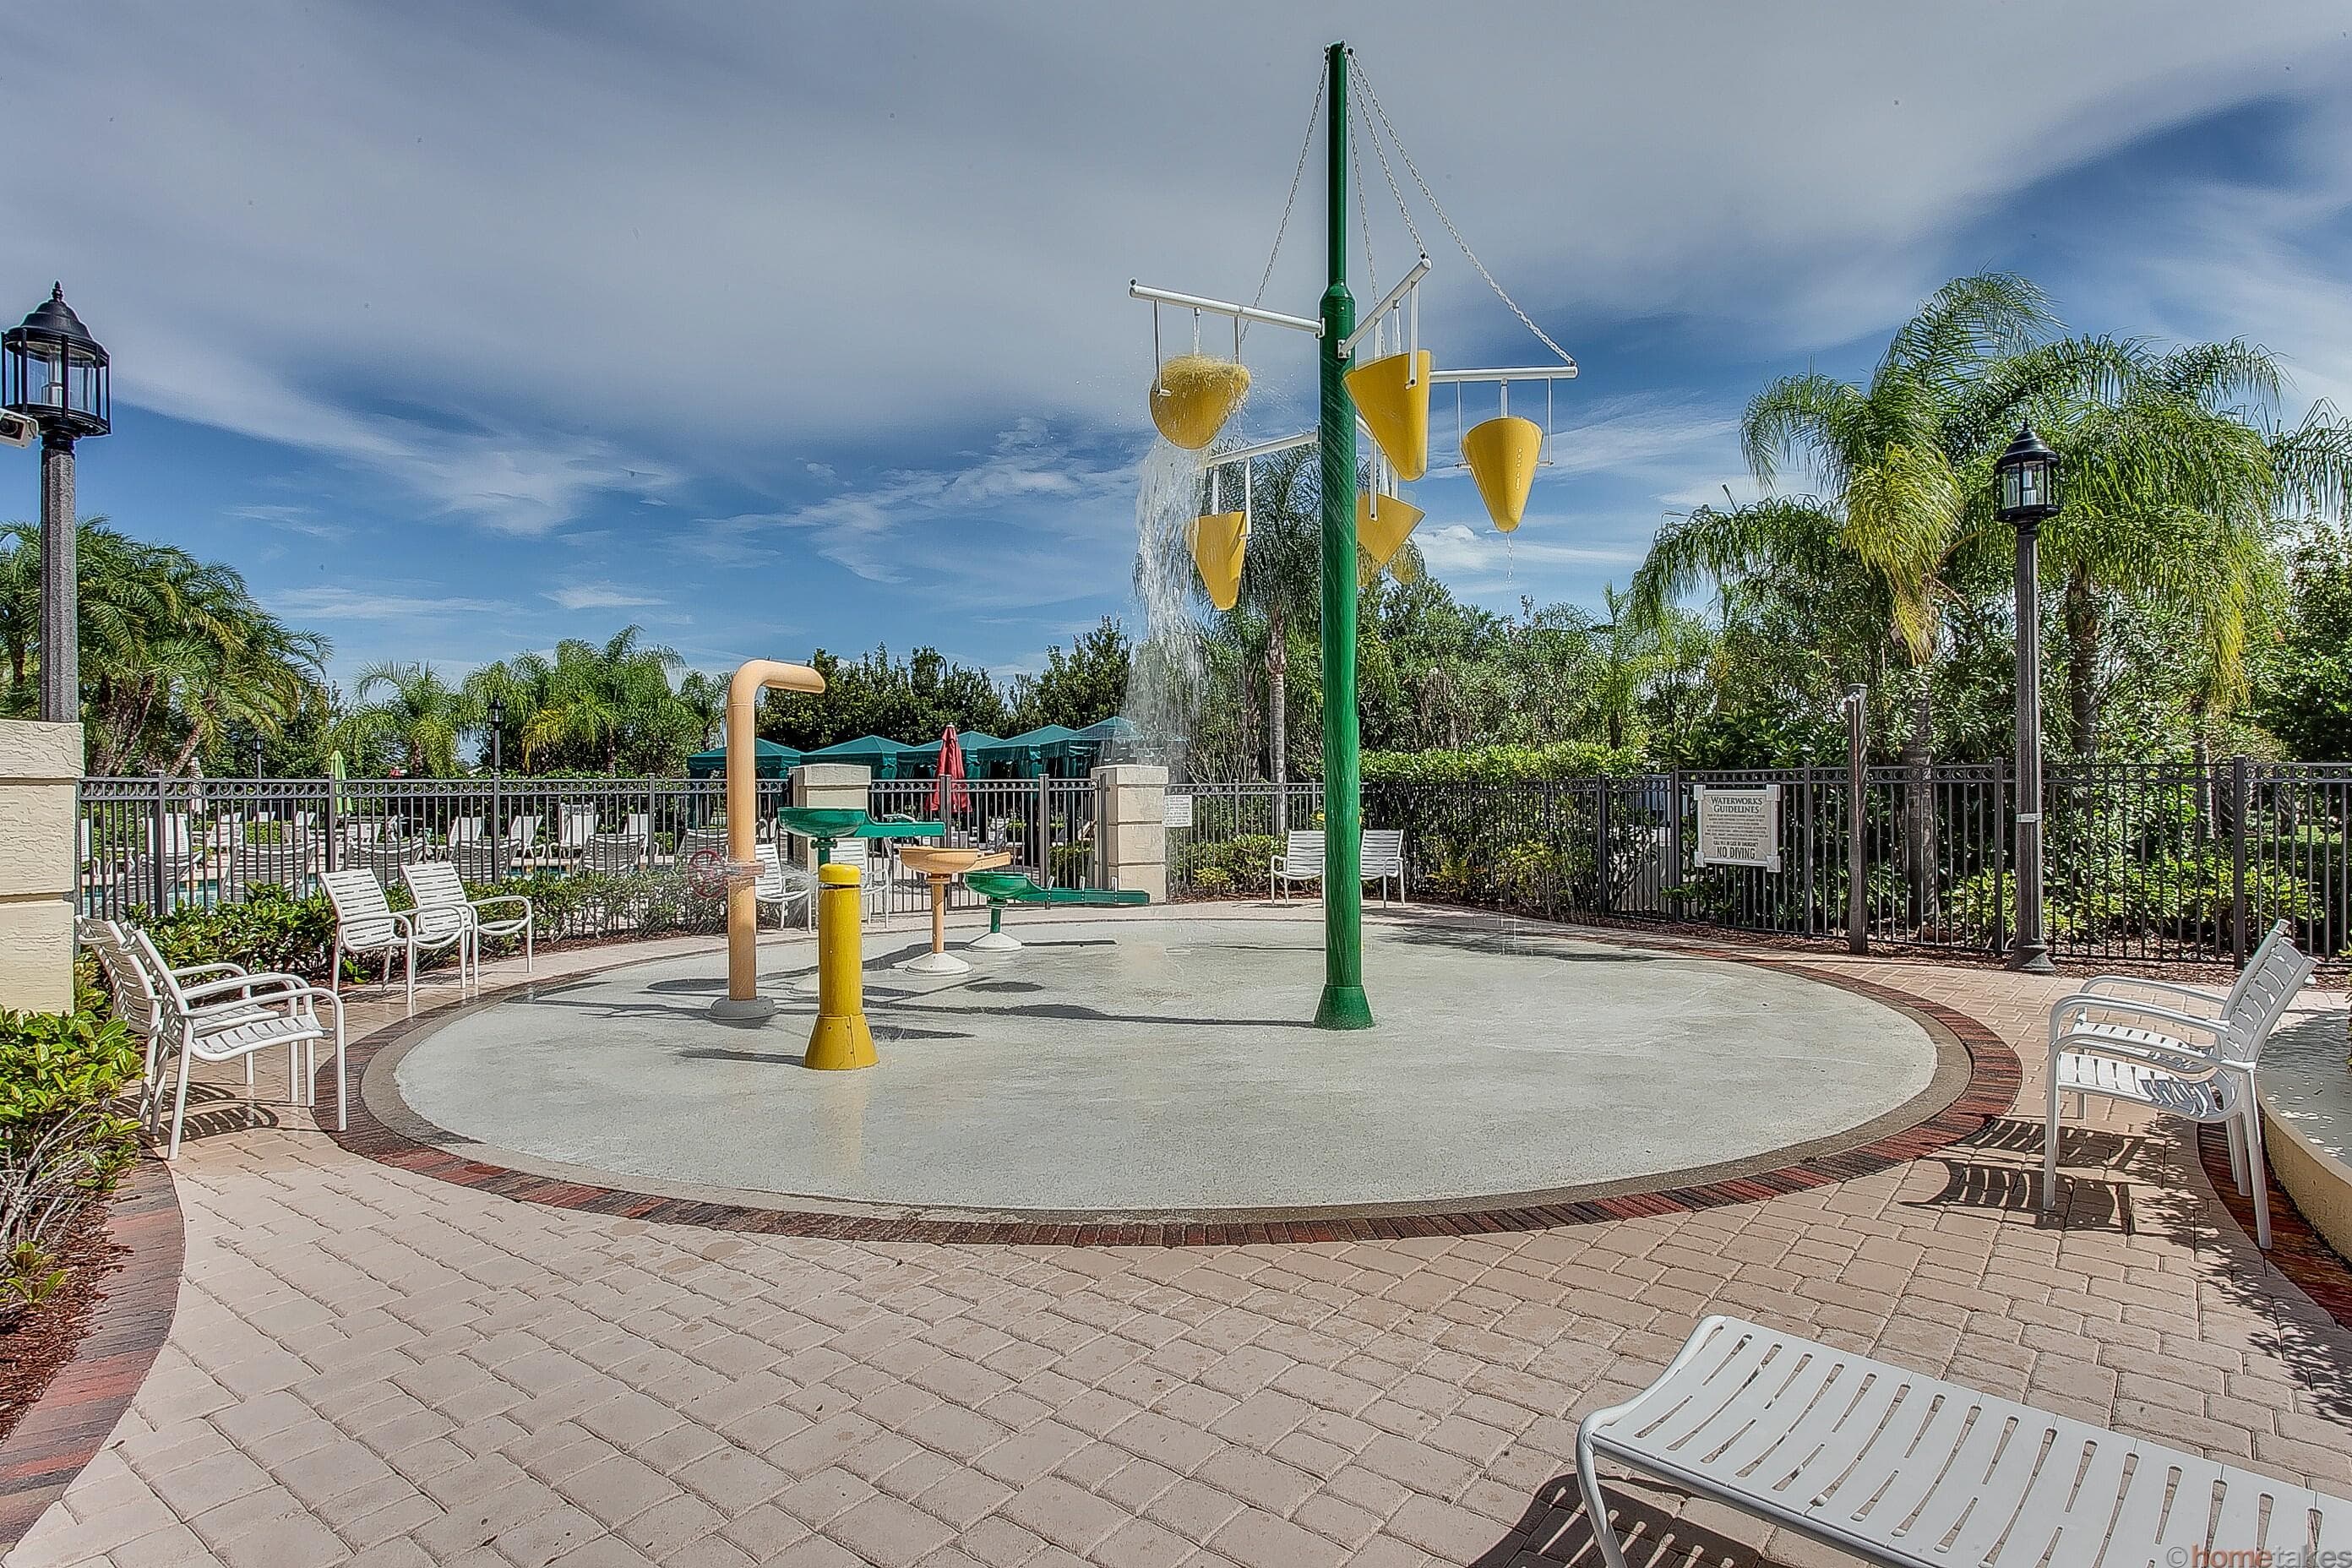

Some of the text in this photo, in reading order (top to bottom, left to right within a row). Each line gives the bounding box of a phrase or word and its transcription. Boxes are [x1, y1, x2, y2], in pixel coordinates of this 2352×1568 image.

[1710, 796, 1763, 805] WATERWORKS
[1713, 804, 1760, 814] GUIDELINES
[1717, 846, 1756, 859] NO DIVING
